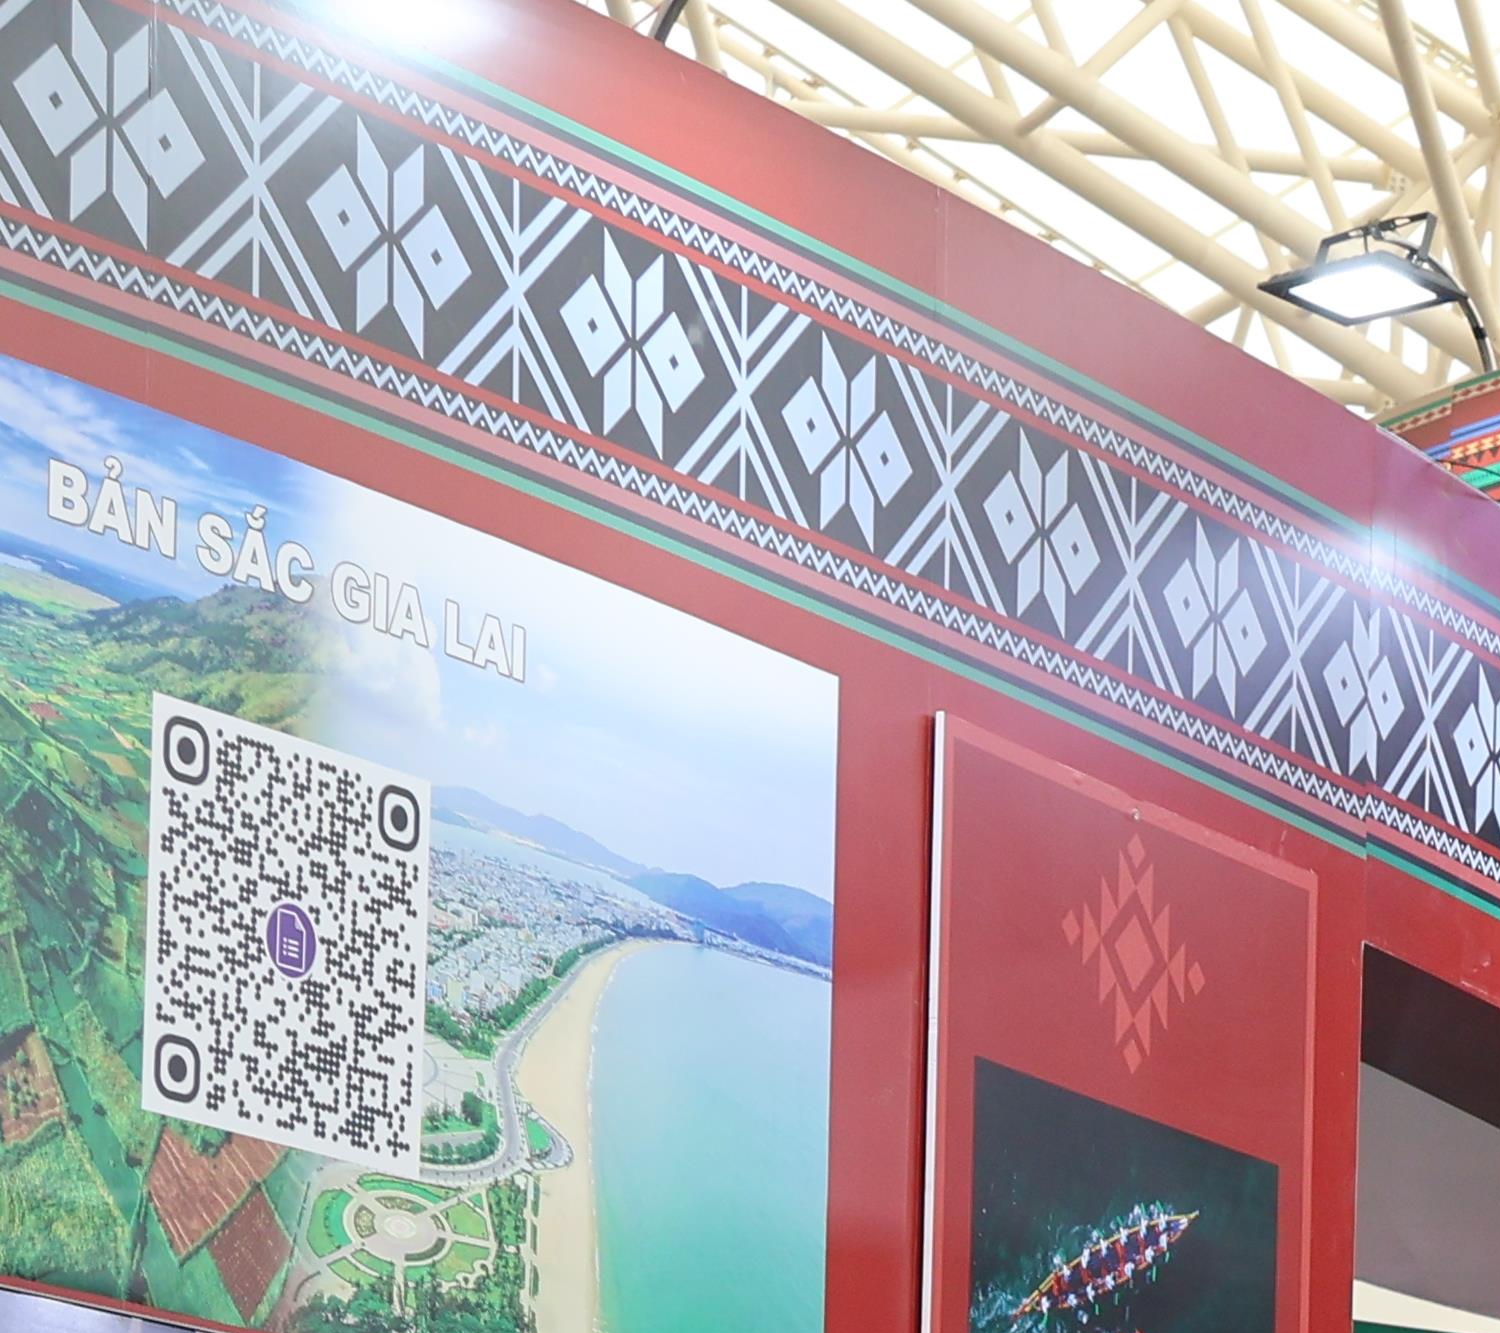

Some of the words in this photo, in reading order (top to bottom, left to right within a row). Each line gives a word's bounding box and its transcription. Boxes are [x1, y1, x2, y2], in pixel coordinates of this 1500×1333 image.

[46, 456, 179, 560] BẢN
[194, 505, 315, 604] SẮC
[329, 561, 434, 656] GIA
[443, 599, 528, 684] LAI
